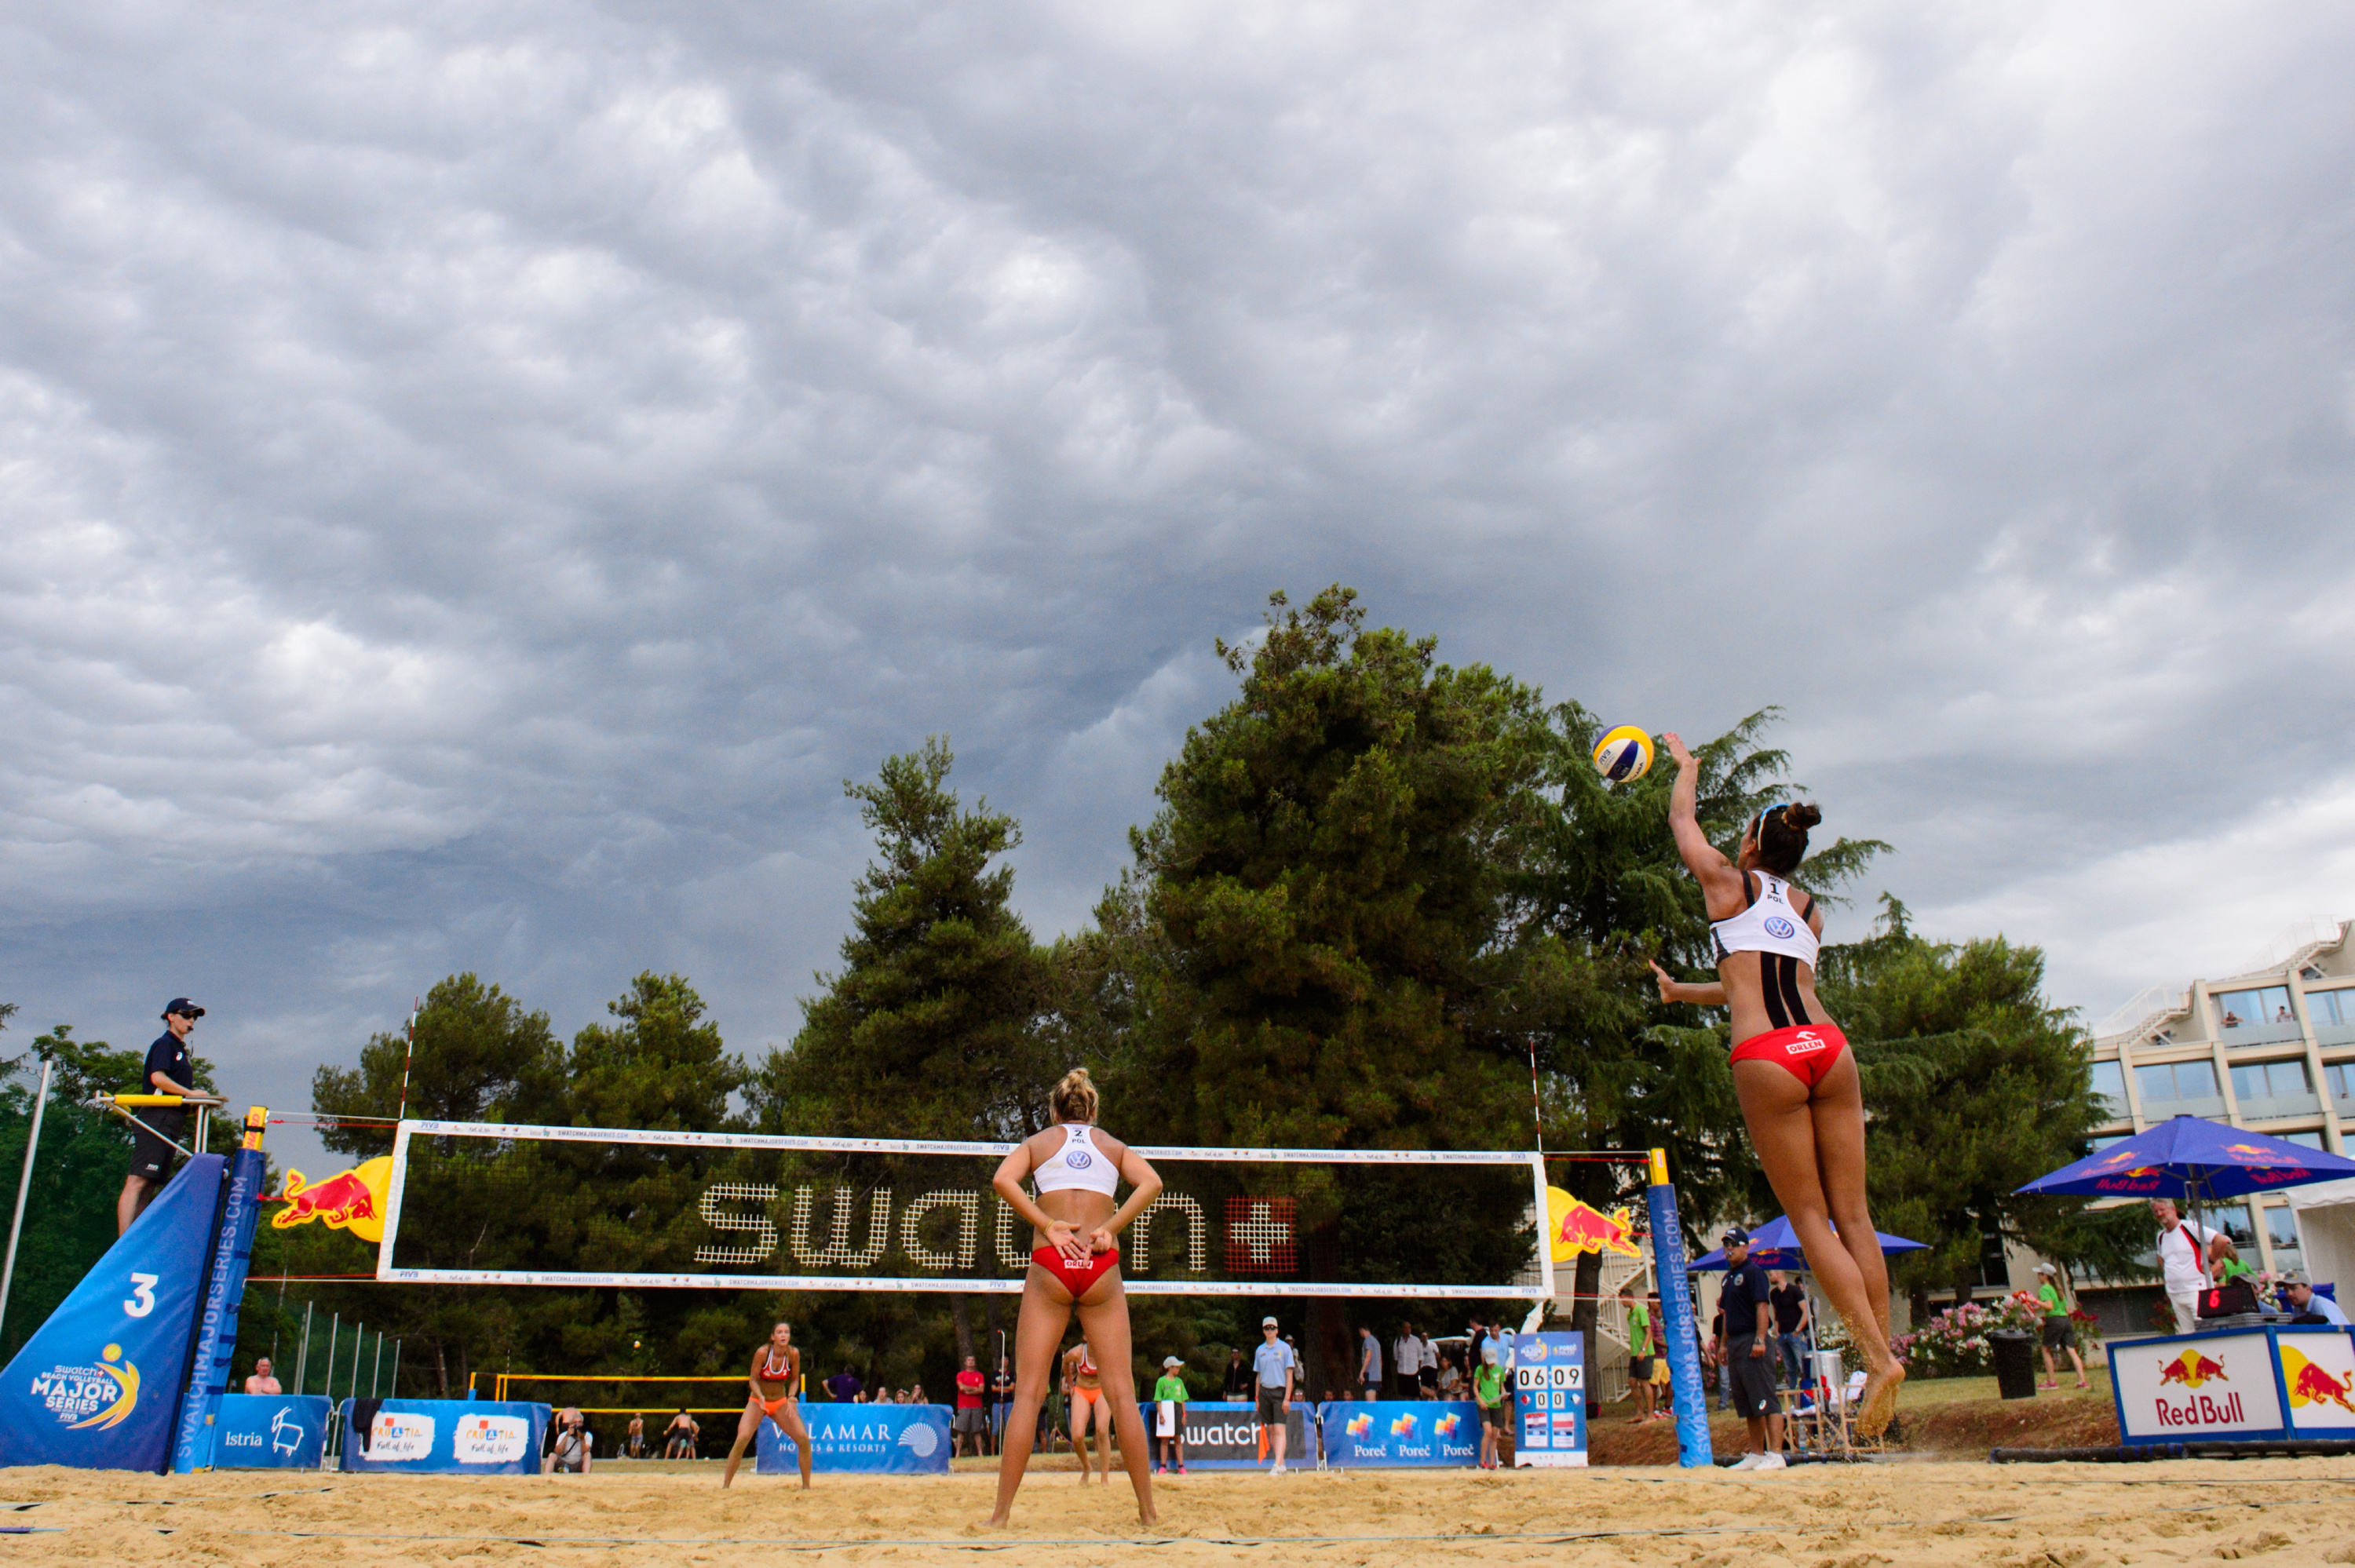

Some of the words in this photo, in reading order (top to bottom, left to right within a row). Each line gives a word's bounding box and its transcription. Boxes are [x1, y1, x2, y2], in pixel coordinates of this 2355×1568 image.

[1770, 883, 1780, 895] 1
[1767, 895, 1784, 904] POL
[1790, 1041, 1823, 1052] ORLEN
[123, 1272, 159, 1318] 3
[2209, 1289, 2221, 1308] 6
[177, 1176, 248, 1458] SWATCHMAJORSERIES.COM
[1662, 1209, 1711, 1453] SWATCHMAJORSERIES.COM
[55, 1365, 97, 1377] swatch
[1520, 1369, 1544, 1386] 06
[1554, 1368, 1579, 1385] 09
[41, 1372, 67, 1380] BEACH
[69, 1374, 114, 1385] VOLLEYBALL
[31, 1377, 118, 1402] MAJOR
[46, 1395, 99, 1412] SERIES
[1538, 1394, 1545, 1406] 0
[1554, 1393, 1561, 1406] 0
[2155, 1395, 2199, 1426] Red
[2199, 1391, 2244, 1424] Bull
[225, 1431, 262, 1447] Istria
[372, 1427, 422, 1439] CROATIA
[466, 1429, 517, 1441] CROATIA
[772, 1423, 892, 1441] VLAMAR
[779, 1442, 821, 1452] HOLS
[826, 1443, 834, 1452] &
[839, 1443, 886, 1453] RESORTS
[1354, 1444, 1387, 1457] Poreč
[1399, 1443, 1431, 1457] Poreč
[1442, 1443, 1475, 1457] Poreč
